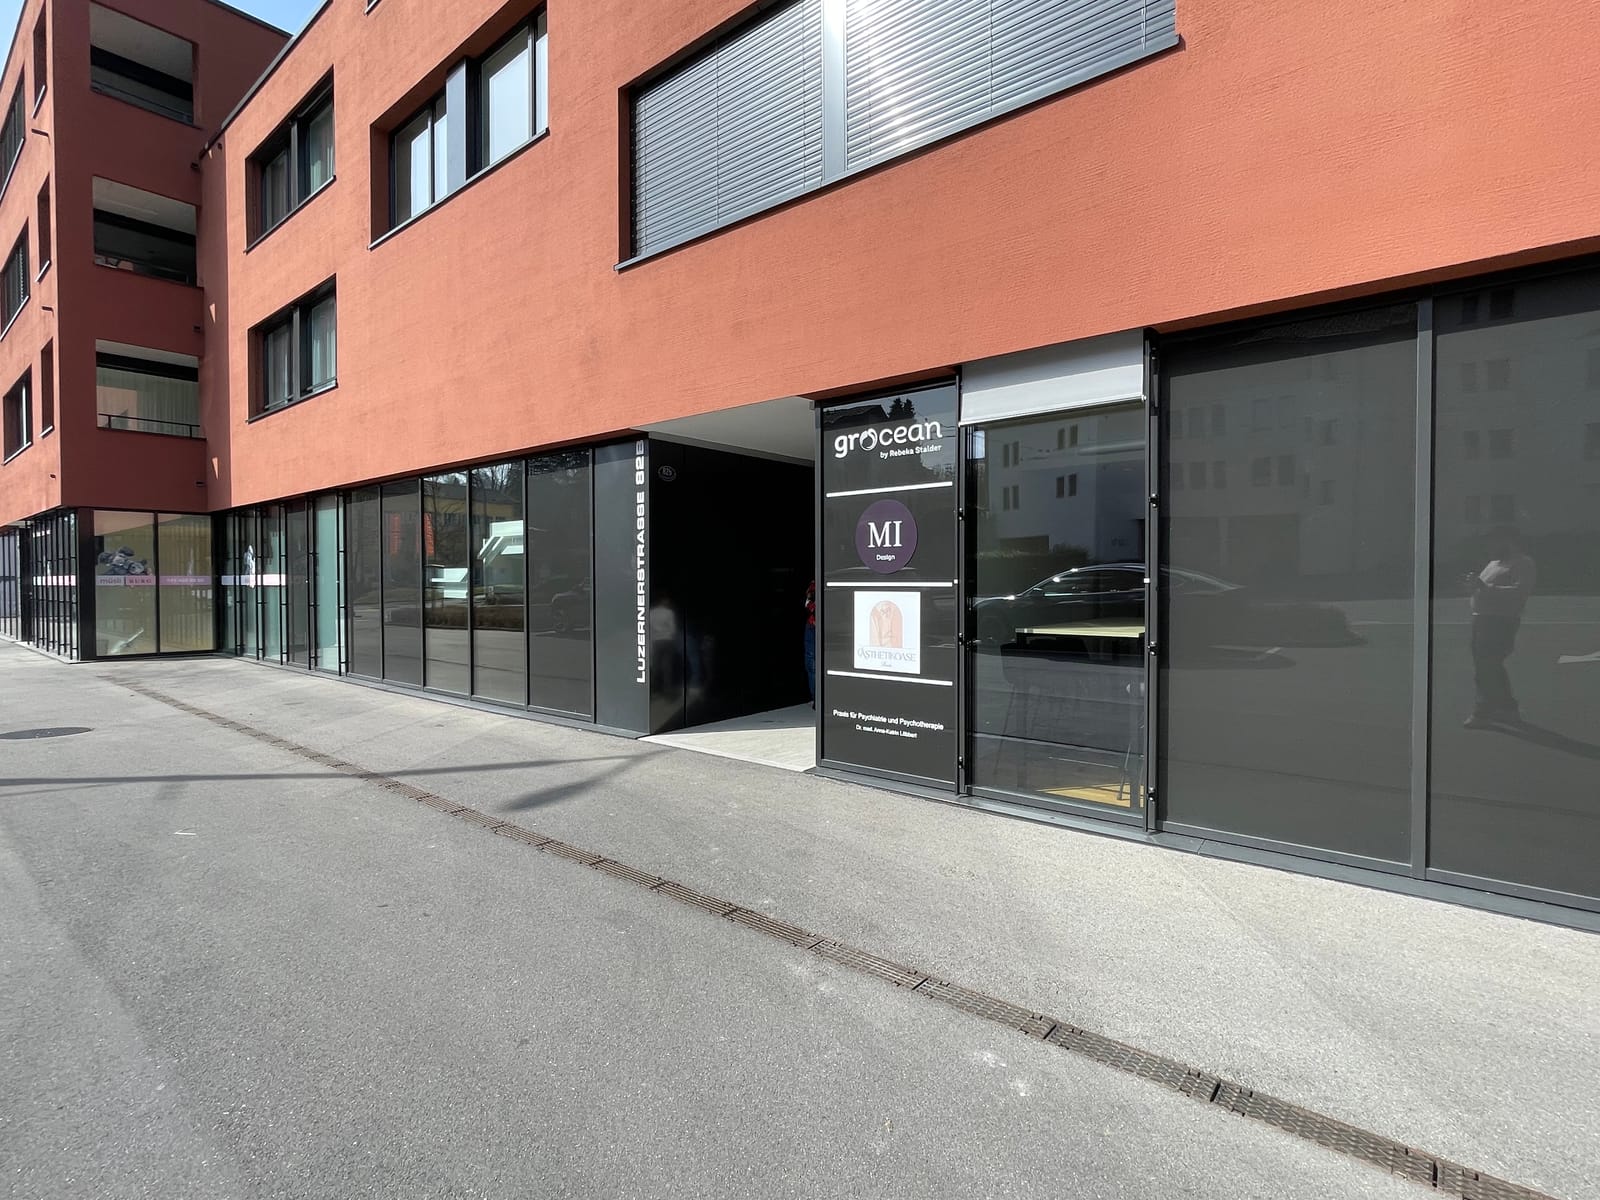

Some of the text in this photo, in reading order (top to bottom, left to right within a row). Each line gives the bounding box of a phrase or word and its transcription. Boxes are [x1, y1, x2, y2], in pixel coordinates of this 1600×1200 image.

[880, 444, 942, 459] by Rebeka Stalder
[867, 520, 903, 548] MI
[876, 554, 896, 562] Design
[636, 491, 646, 683] LUZERNERSTRASSE
[832, 709, 850, 718] Praxis
[850, 711, 858, 719] für
[858, 712, 887, 722] Psychiatrie
[899, 718, 944, 731] Psychotherapie
